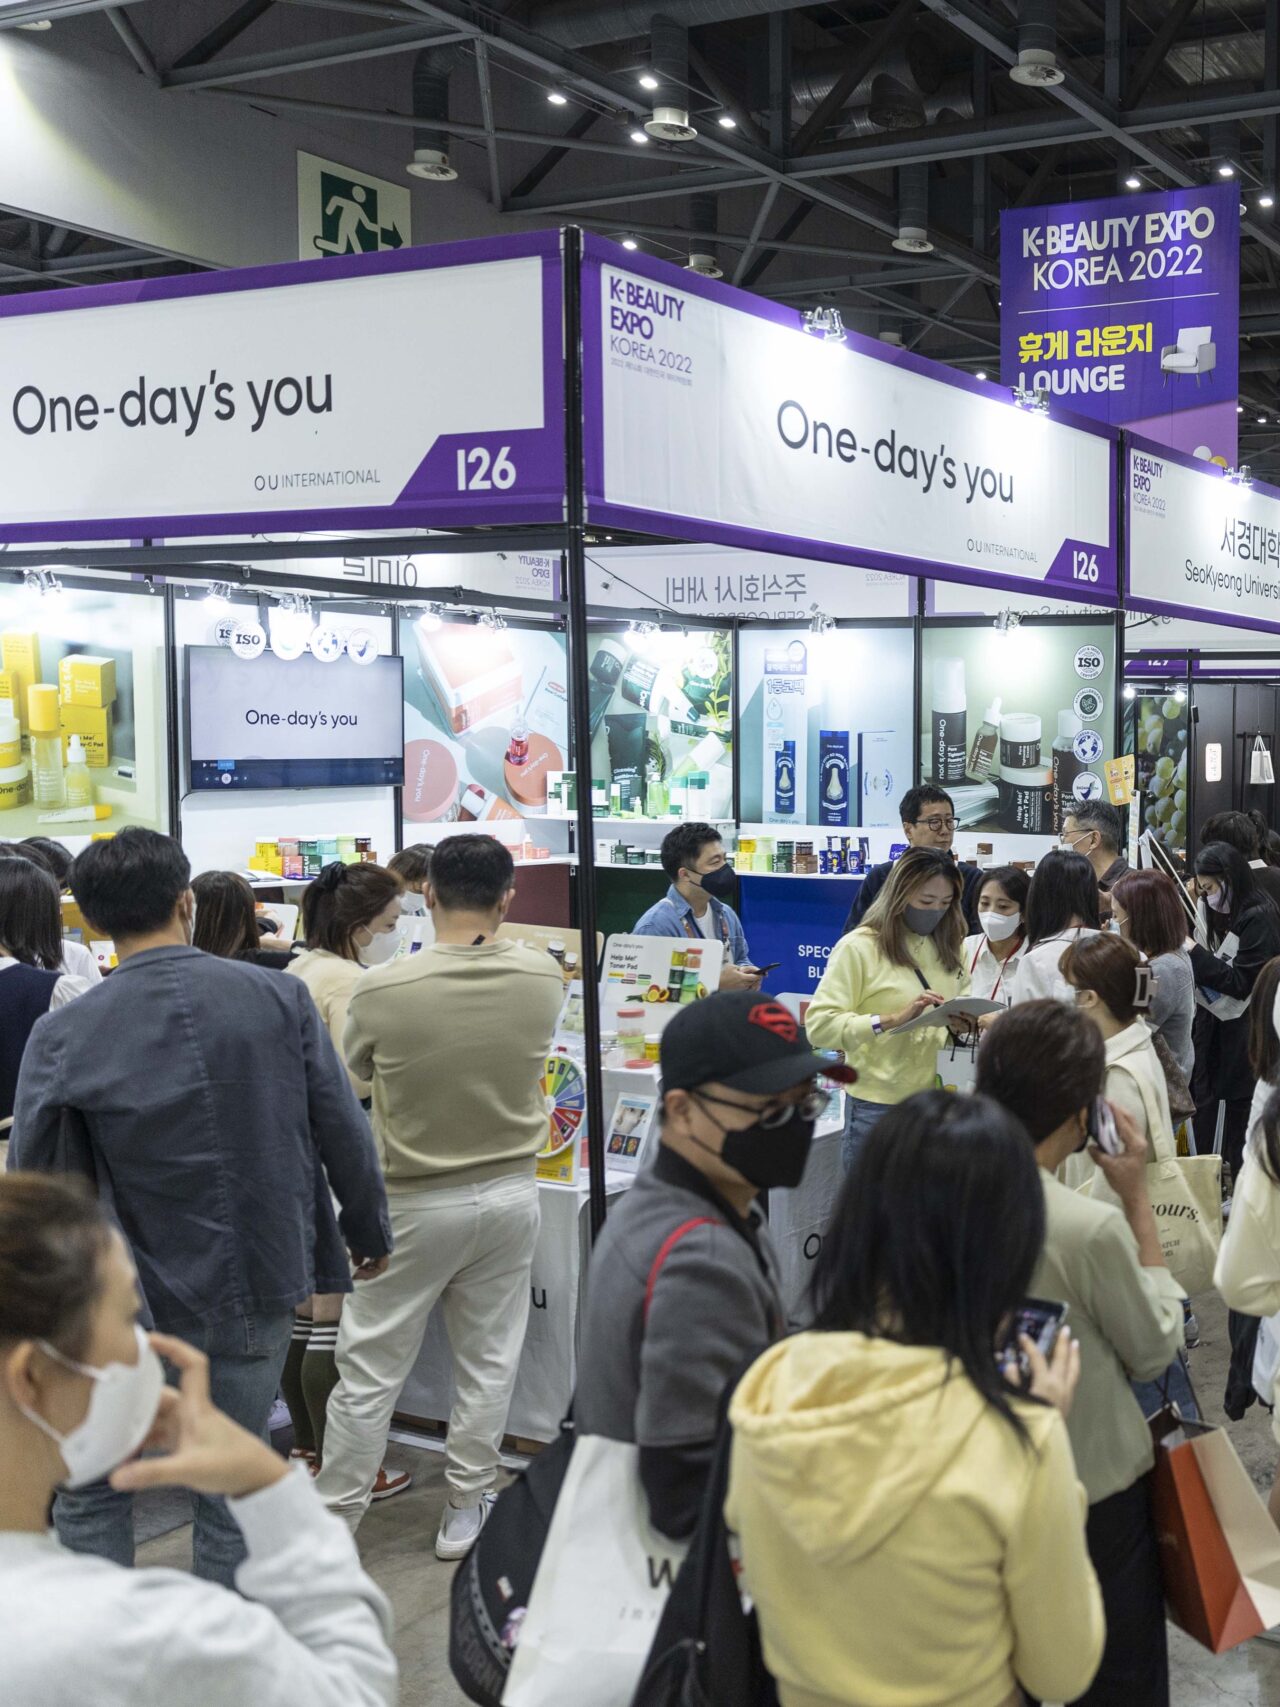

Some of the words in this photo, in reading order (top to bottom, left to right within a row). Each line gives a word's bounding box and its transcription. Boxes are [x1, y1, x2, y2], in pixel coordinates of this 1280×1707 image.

[1022, 215, 1140, 258] K-BEAUTY
[1145, 206, 1215, 244] EXPO
[1033, 253, 1124, 291] KOREA
[1129, 244, 1203, 281] 2022
[610, 276, 685, 321] K-BEAUTY
[610, 306, 654, 340] EXPO
[610, 335, 656, 364] KOREA
[658, 349, 692, 374] 2022
[1018, 330, 1069, 363] 휴게
[1076, 322, 1153, 358] 라운지
[1018, 364, 1126, 396] LOUNGE
[13, 369, 236, 437] One-day's
[247, 373, 333, 432] you
[777, 399, 957, 493] One-day's
[964, 462, 1014, 504] you
[1133, 454, 1163, 479] K-BEAUTY
[281, 469, 380, 489] INTERNATIONAL
[1133, 473, 1151, 492] EXPO
[983, 541, 1038, 563] INTERNATIONAL
[1185, 558, 1242, 597] SeoKyeong
[219, 628, 232, 639] IS
[235, 633, 260, 646] ISO
[1078, 657, 1101, 668] ISO
[245, 709, 328, 729] One-day's
[332, 712, 358, 729] you
[938, 719, 946, 762] One-day's
[1151, 1202, 1200, 1224] ours.
